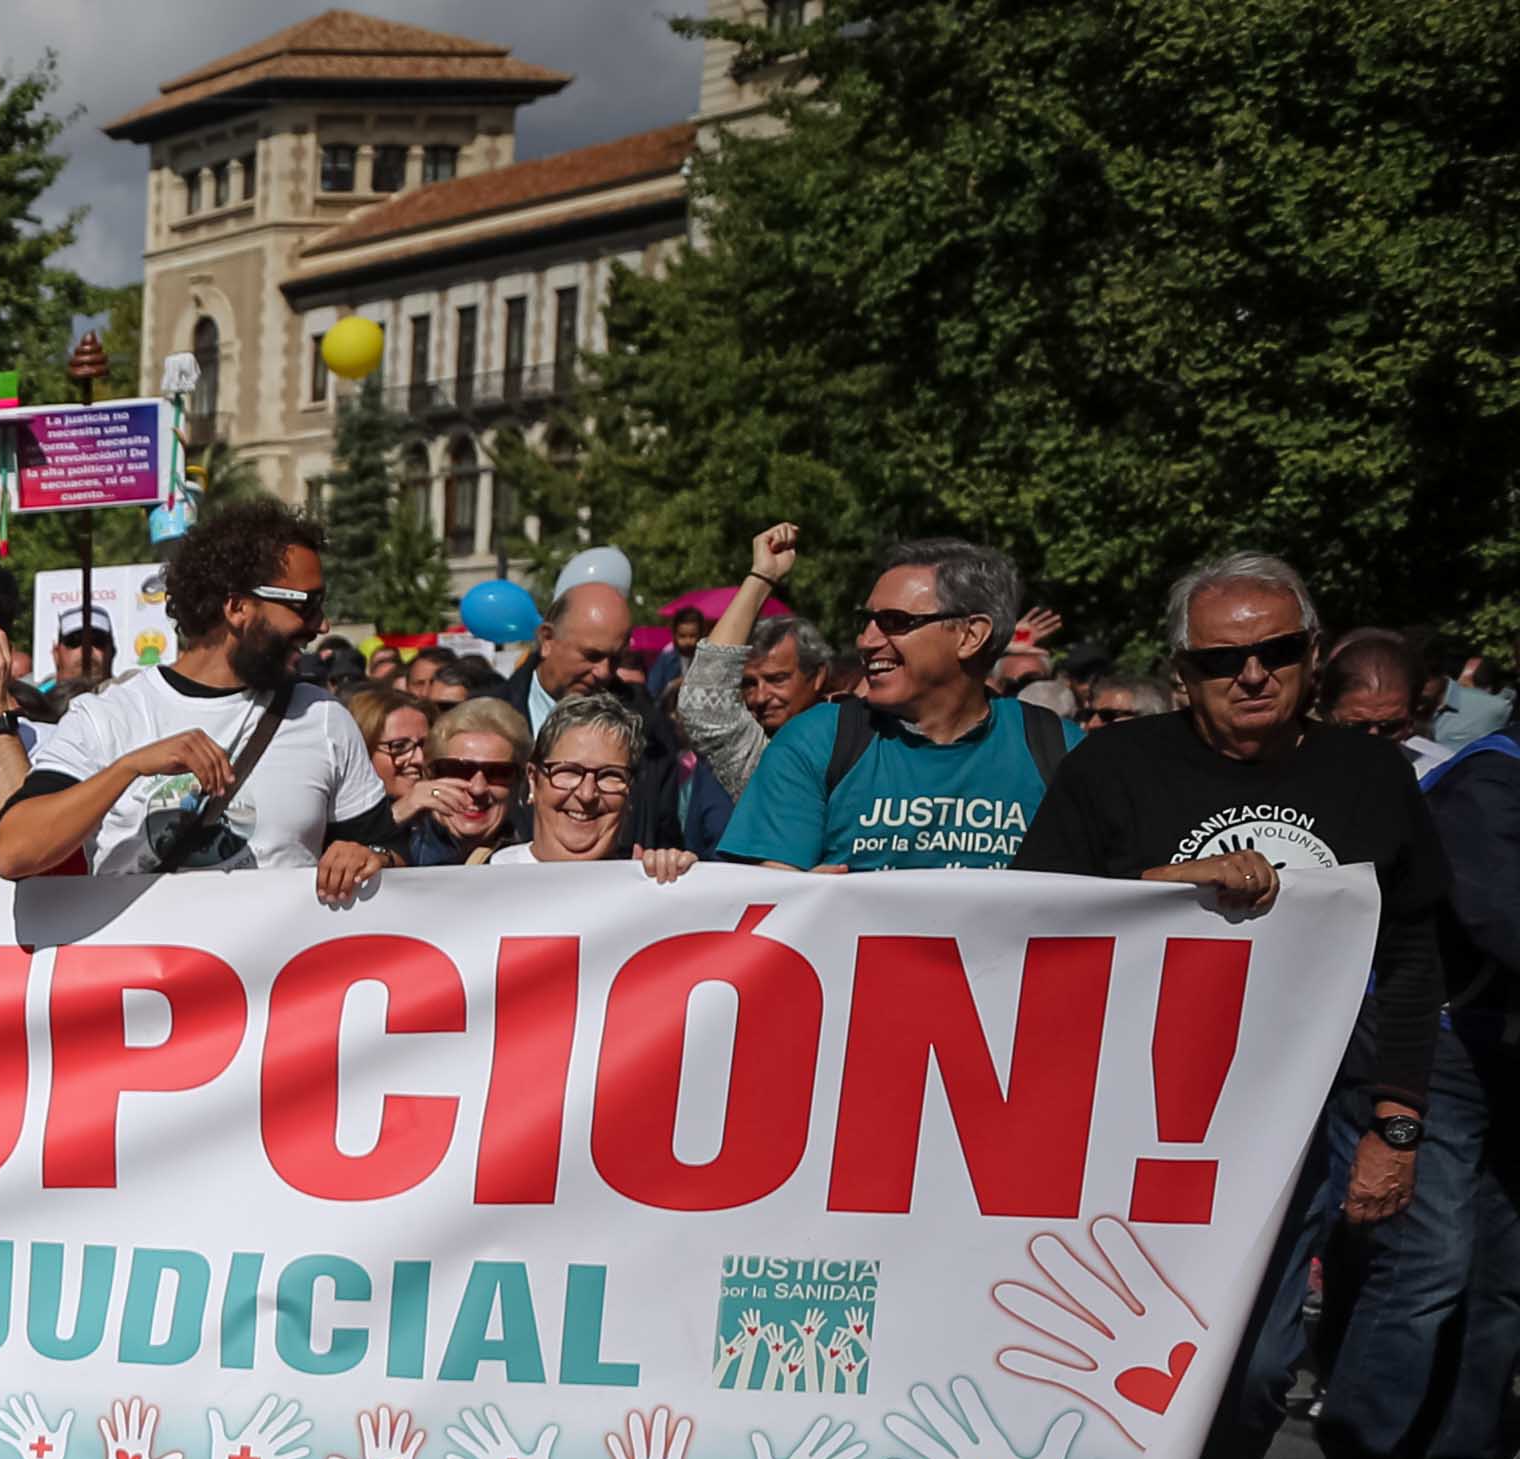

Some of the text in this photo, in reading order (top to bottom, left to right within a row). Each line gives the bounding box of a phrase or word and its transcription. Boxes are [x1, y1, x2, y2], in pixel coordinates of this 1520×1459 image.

[64, 412, 110, 426] justicia
[113, 411, 129, 421] no
[47, 426, 102, 439] necesita
[96, 436, 151, 448] necesita
[859, 796, 1027, 832] JUSTICIA
[852, 835, 888, 854] por
[891, 834, 909, 851] la
[1170, 804, 1315, 864] RGANIZACION
[720, 1254, 879, 1282] JUSTICIA
[752, 1284, 768, 1299] la
[773, 1282, 878, 1302] SANIDAD
